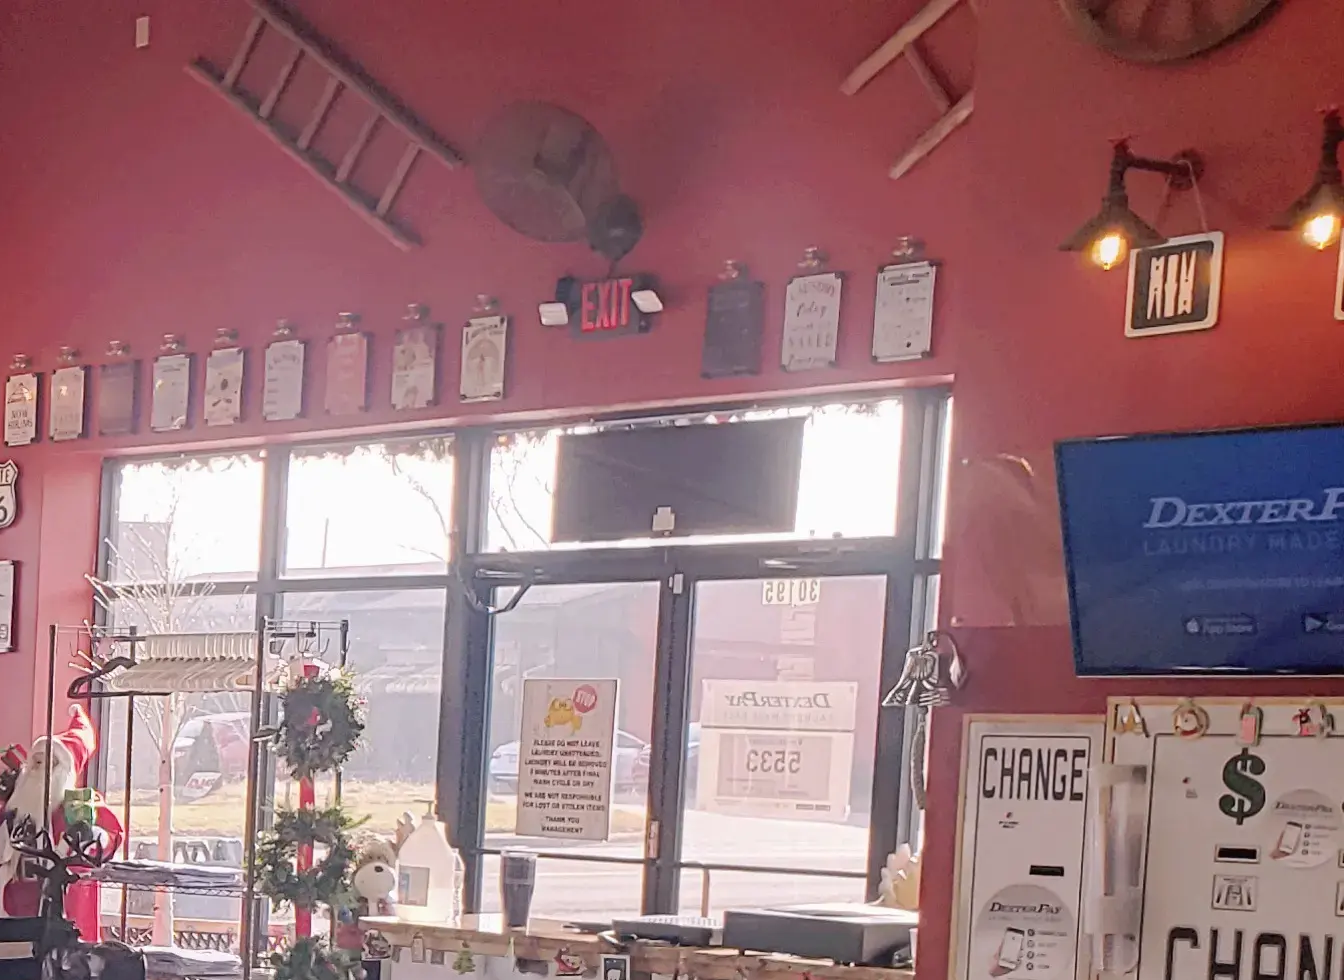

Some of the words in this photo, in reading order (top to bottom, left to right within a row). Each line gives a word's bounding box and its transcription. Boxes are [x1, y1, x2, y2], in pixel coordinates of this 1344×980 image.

[581, 278, 633, 332] EXIT
[1144, 532, 1256, 557] LAUNDRY
[1268, 529, 1341, 552] MADE
[982, 747, 1087, 802] CHANGE
[1218, 747, 1268, 826] $
